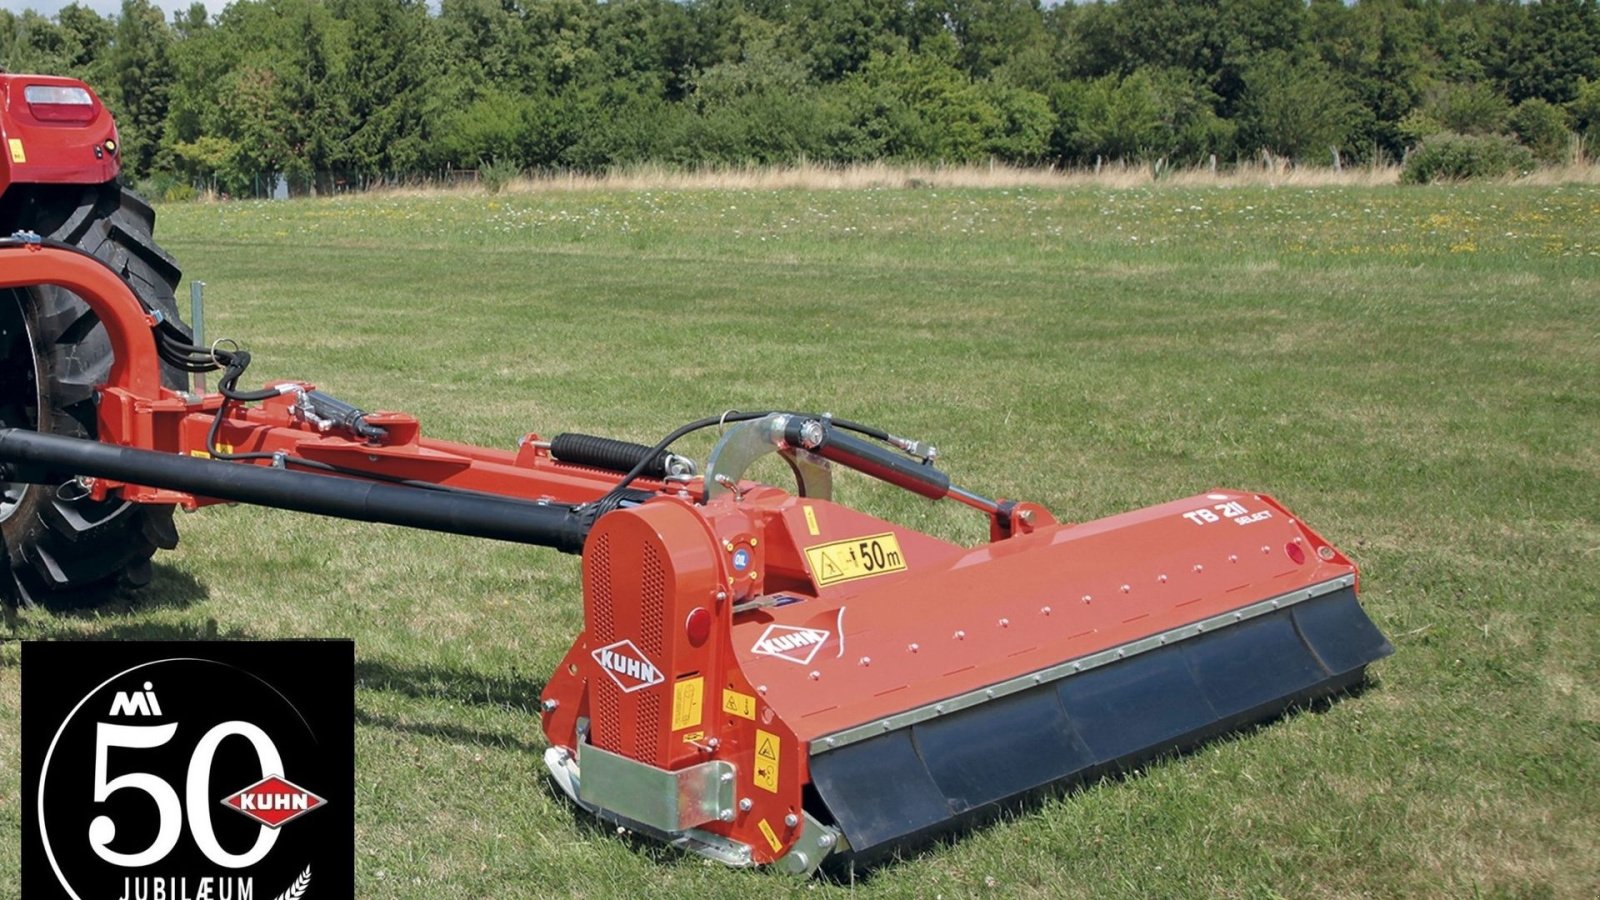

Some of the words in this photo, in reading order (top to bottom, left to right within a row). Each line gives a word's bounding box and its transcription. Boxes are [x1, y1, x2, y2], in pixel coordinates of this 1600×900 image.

[1182, 508, 1219, 526] TB
[1214, 501, 1248, 518] 211
[1234, 510, 1272, 526] SELECT
[760, 629, 822, 654] KUHN
[601, 649, 655, 683] KUHN
